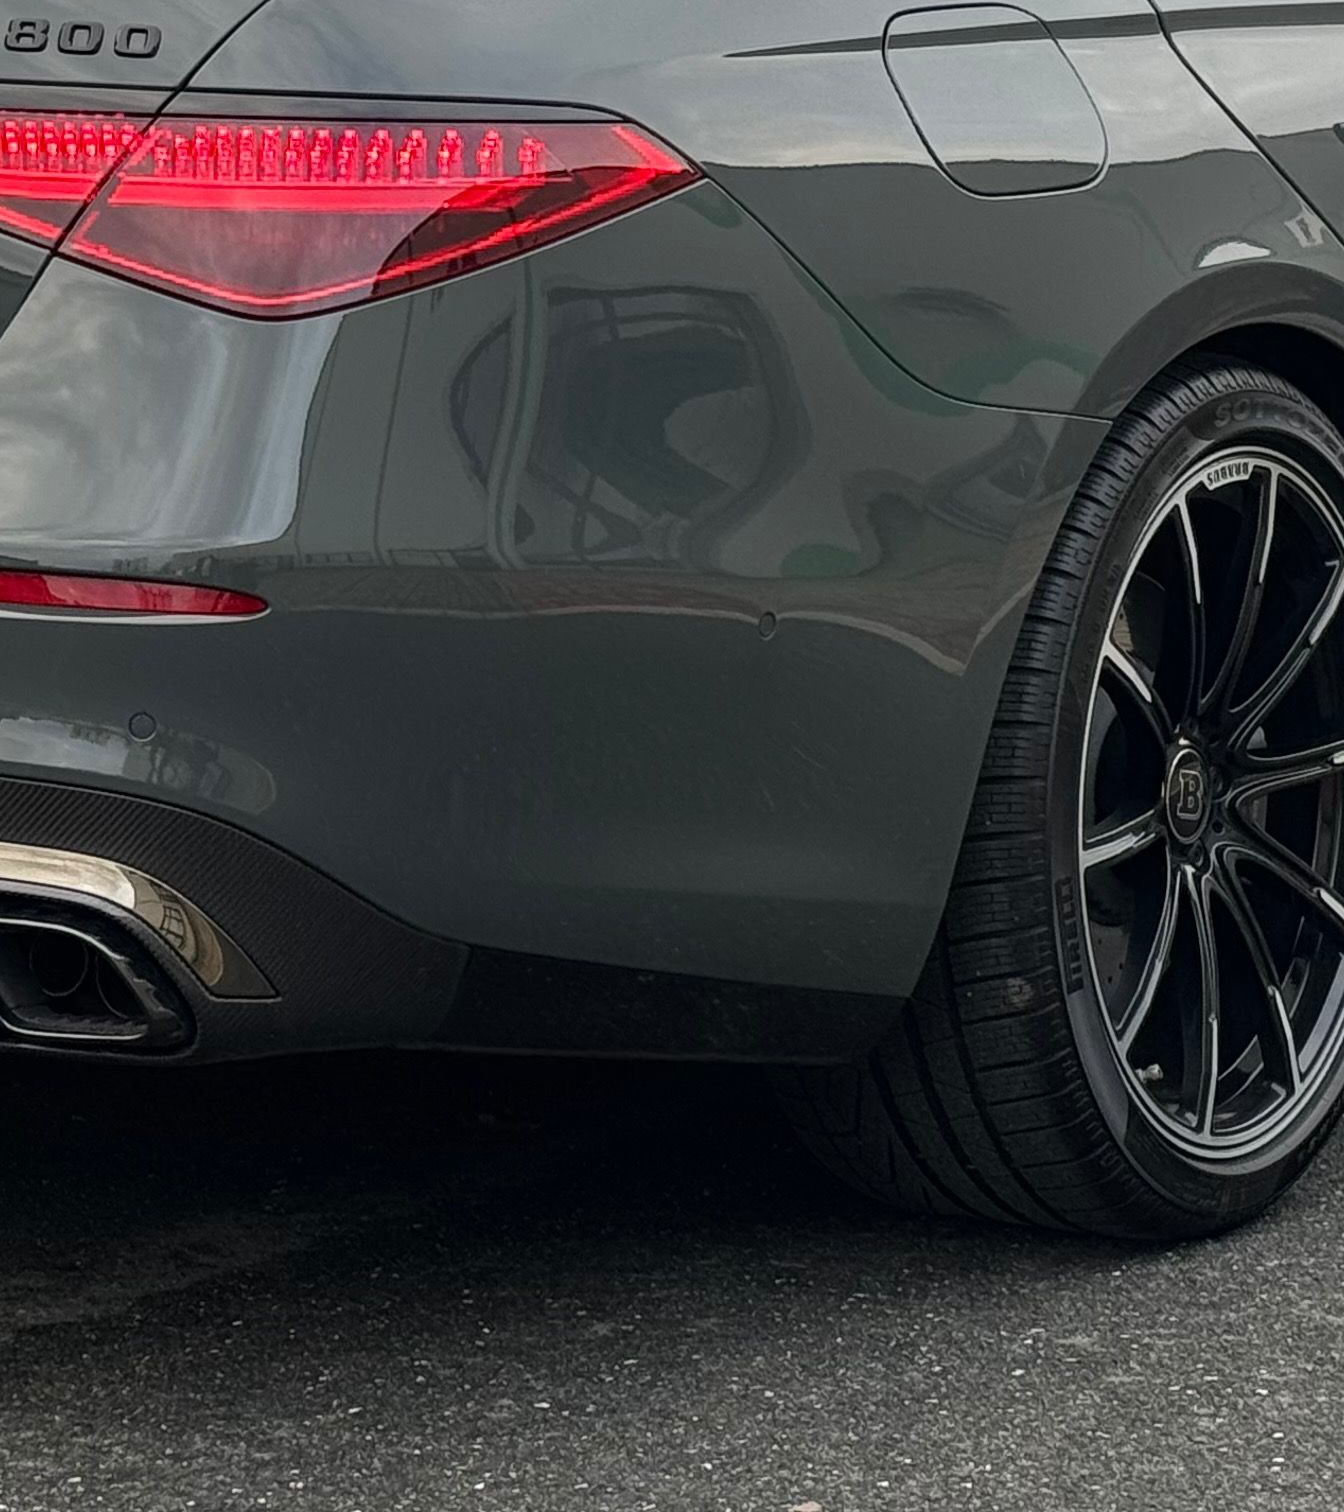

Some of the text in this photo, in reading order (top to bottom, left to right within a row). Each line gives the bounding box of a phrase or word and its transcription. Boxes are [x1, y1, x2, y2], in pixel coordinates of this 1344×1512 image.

[4, 18, 162, 58] 800
[1206, 461, 1250, 486] BRABUS
[1177, 769, 1203, 820] B
